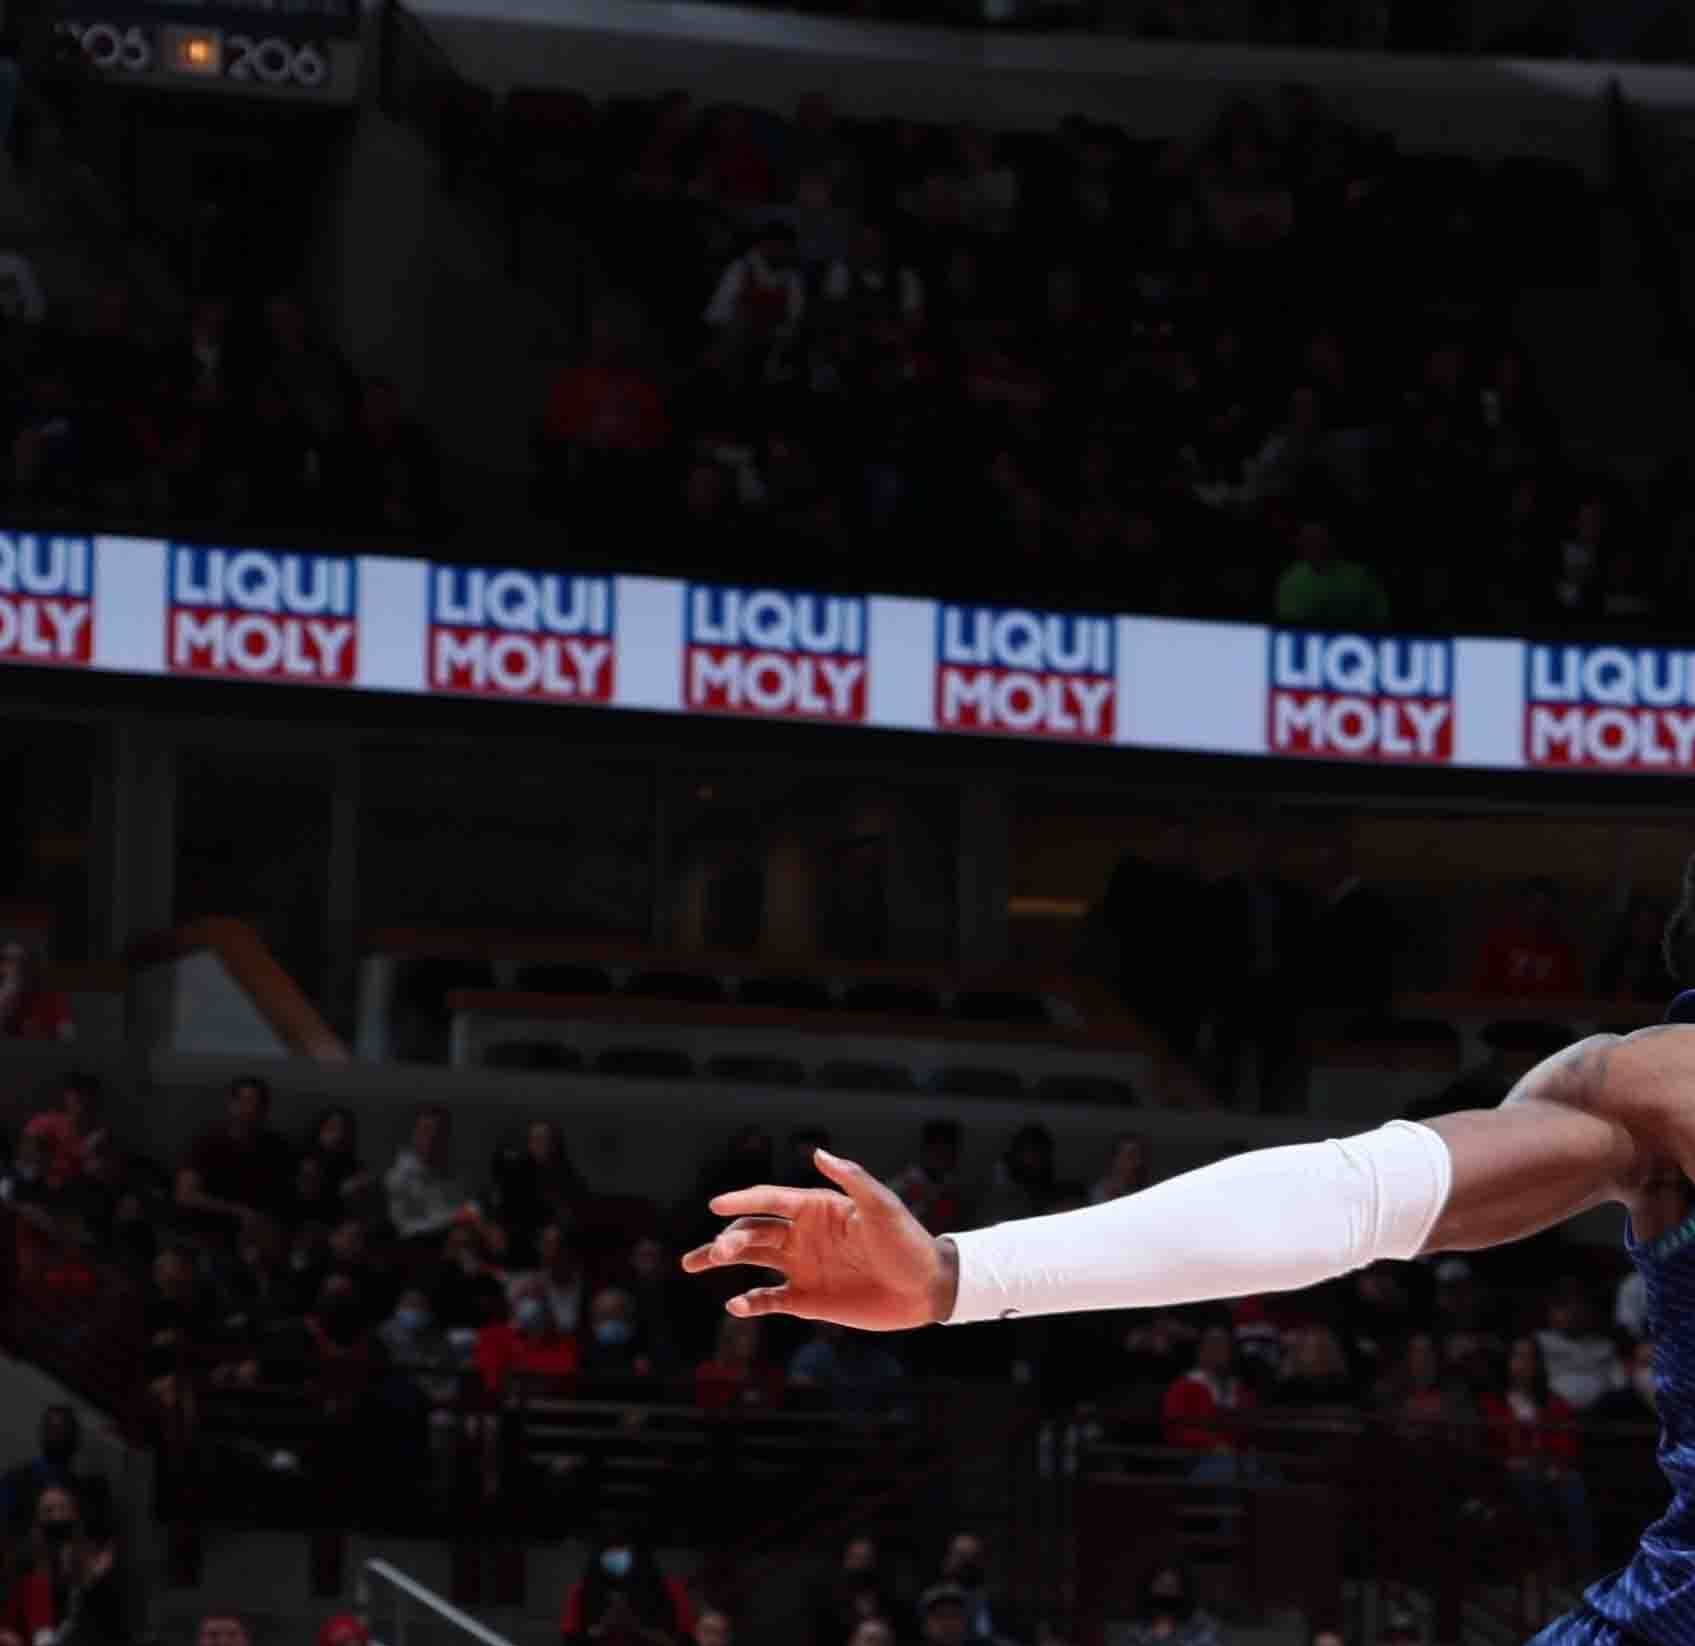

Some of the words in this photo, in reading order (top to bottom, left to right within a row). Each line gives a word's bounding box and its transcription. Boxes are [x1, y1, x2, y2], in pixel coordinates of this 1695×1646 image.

[175, 546, 350, 614] LIQUI
[439, 566, 608, 635] LIQUI
[172, 609, 352, 676] MOLY
[691, 588, 860, 654] LIQUI
[942, 606, 1112, 672] LIQUI
[434, 629, 612, 697] MOLY
[688, 648, 864, 715] MOLY
[1278, 633, 1448, 697] LIQUI
[940, 667, 1115, 735] MOLY
[1276, 694, 1451, 756] MOLY
